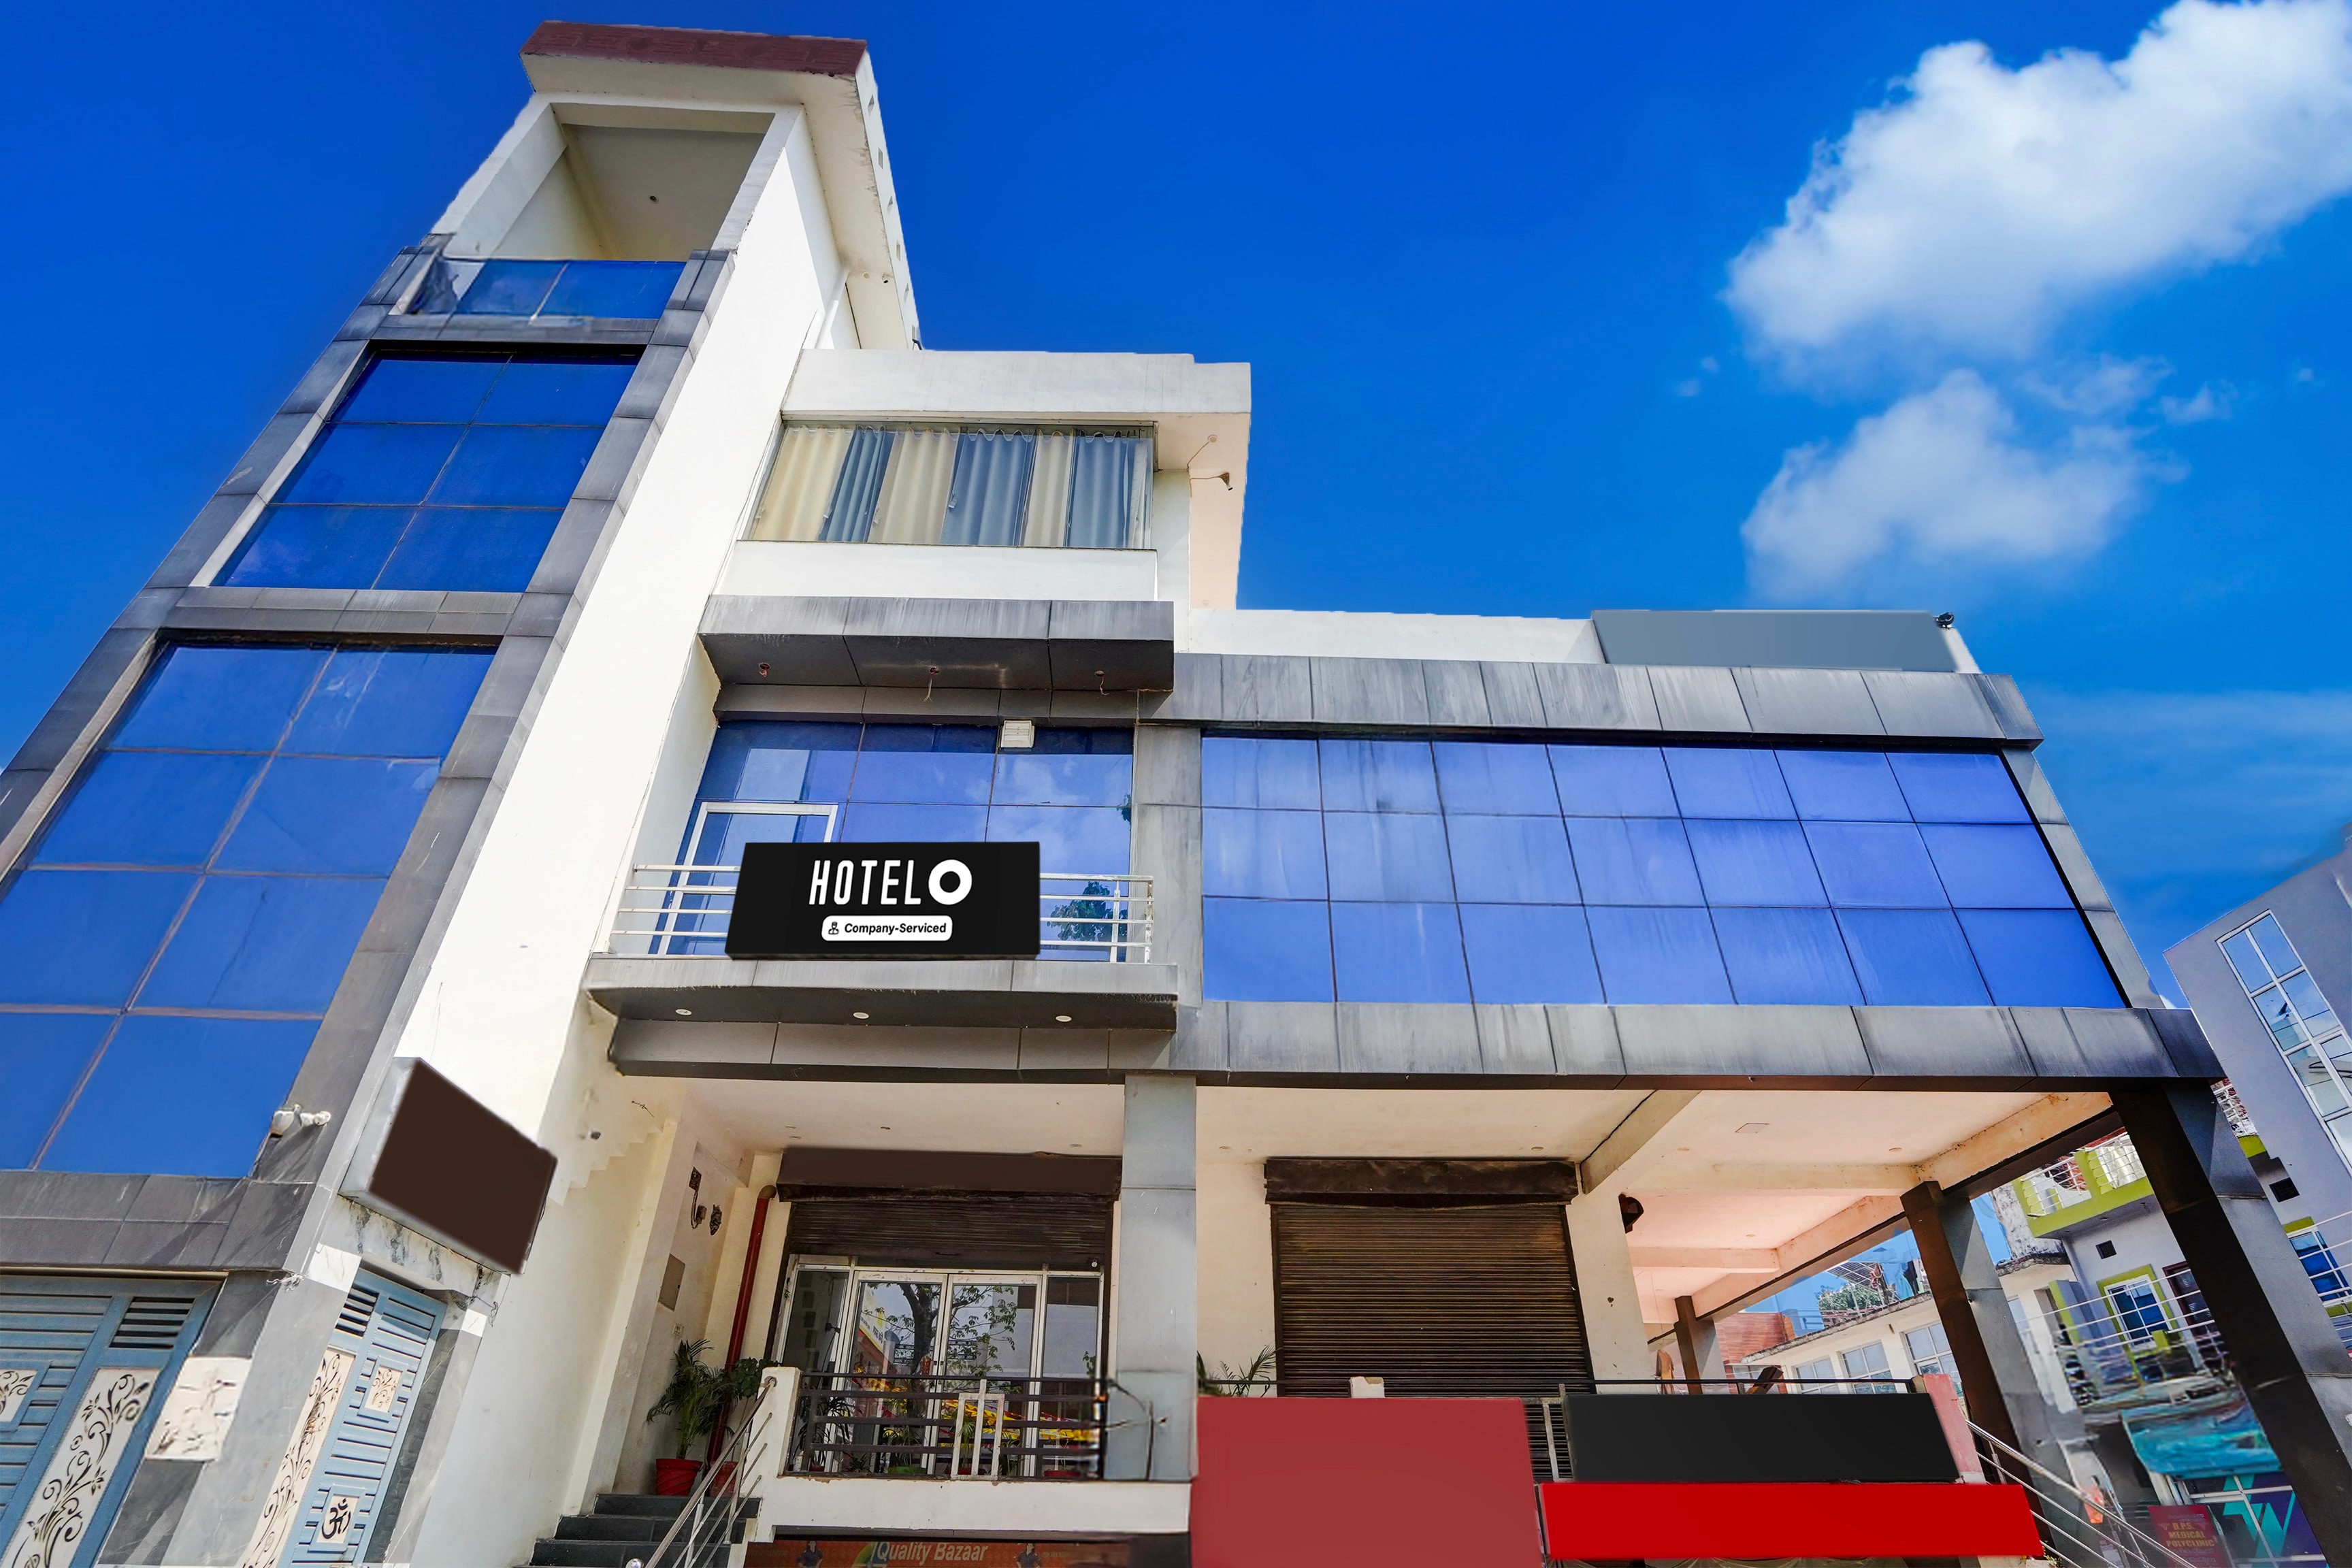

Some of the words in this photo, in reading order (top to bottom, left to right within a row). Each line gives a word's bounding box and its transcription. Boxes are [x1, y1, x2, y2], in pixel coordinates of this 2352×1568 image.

[808, 860, 921, 905] HOTEL
[844, 922, 947, 935] Company-Serviced
[877, 1541, 932, 1566] Quality
[933, 1542, 989, 1562] Bazaar
